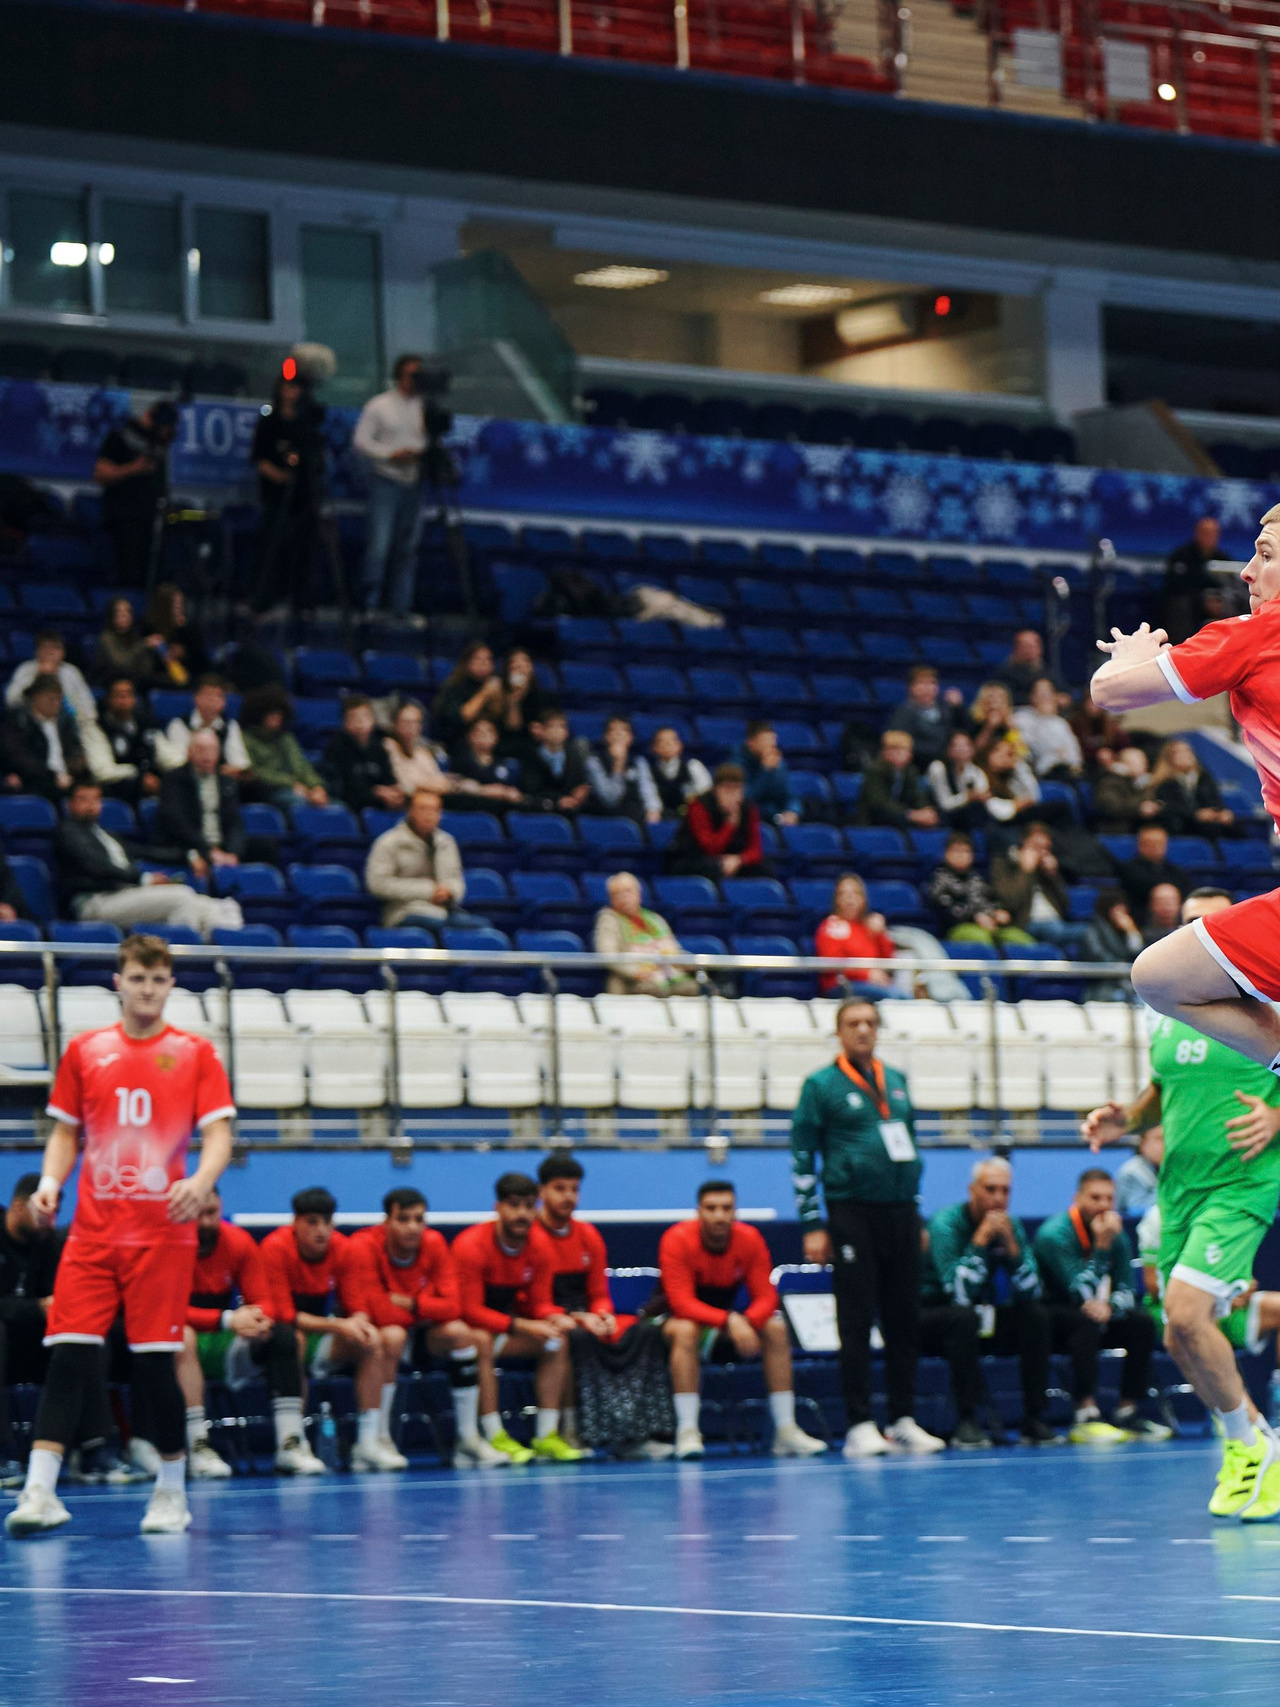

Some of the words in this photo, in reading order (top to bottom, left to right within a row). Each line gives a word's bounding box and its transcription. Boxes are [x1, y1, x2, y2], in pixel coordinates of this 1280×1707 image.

[181, 406, 260, 458] 105
[1175, 1038, 1208, 1065] 89
[115, 1086, 153, 1127] 10
